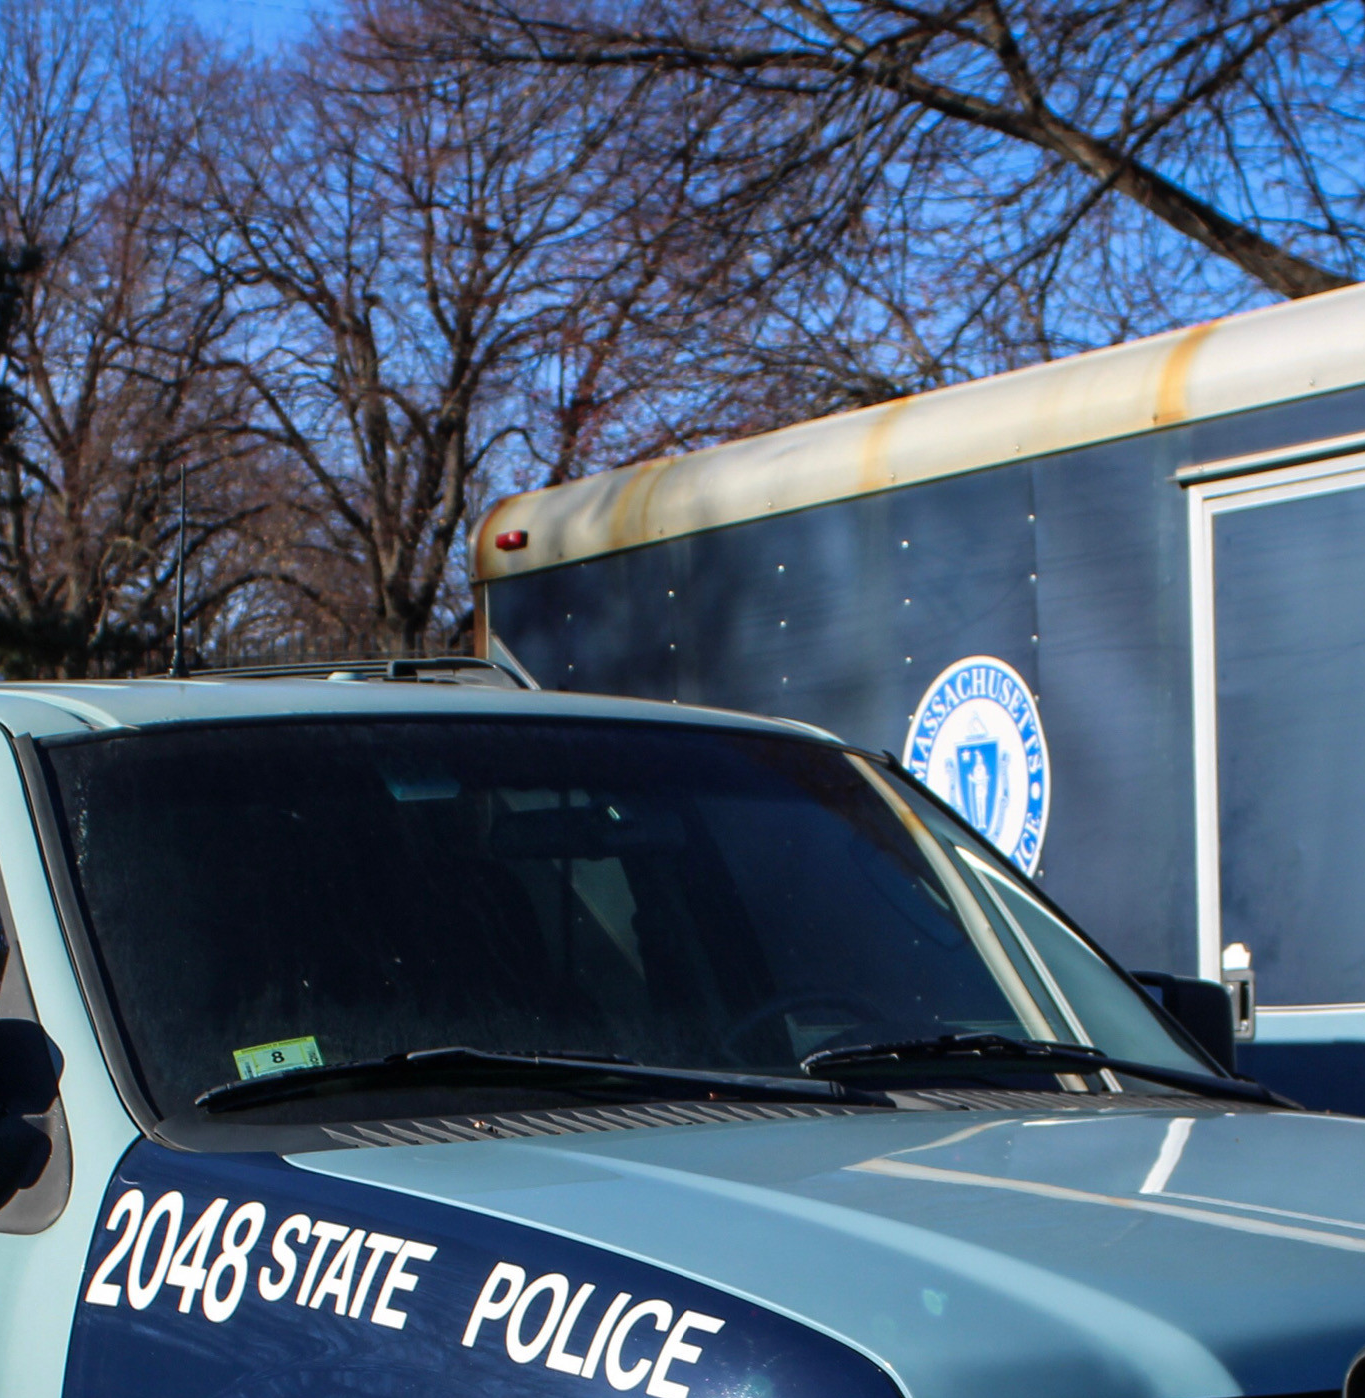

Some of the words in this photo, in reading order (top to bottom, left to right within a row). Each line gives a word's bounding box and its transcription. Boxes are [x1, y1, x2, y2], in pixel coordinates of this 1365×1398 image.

[271, 1051, 285, 1064] 8
[84, 1188, 267, 1324] 2048
[257, 1213, 438, 1330] STATE
